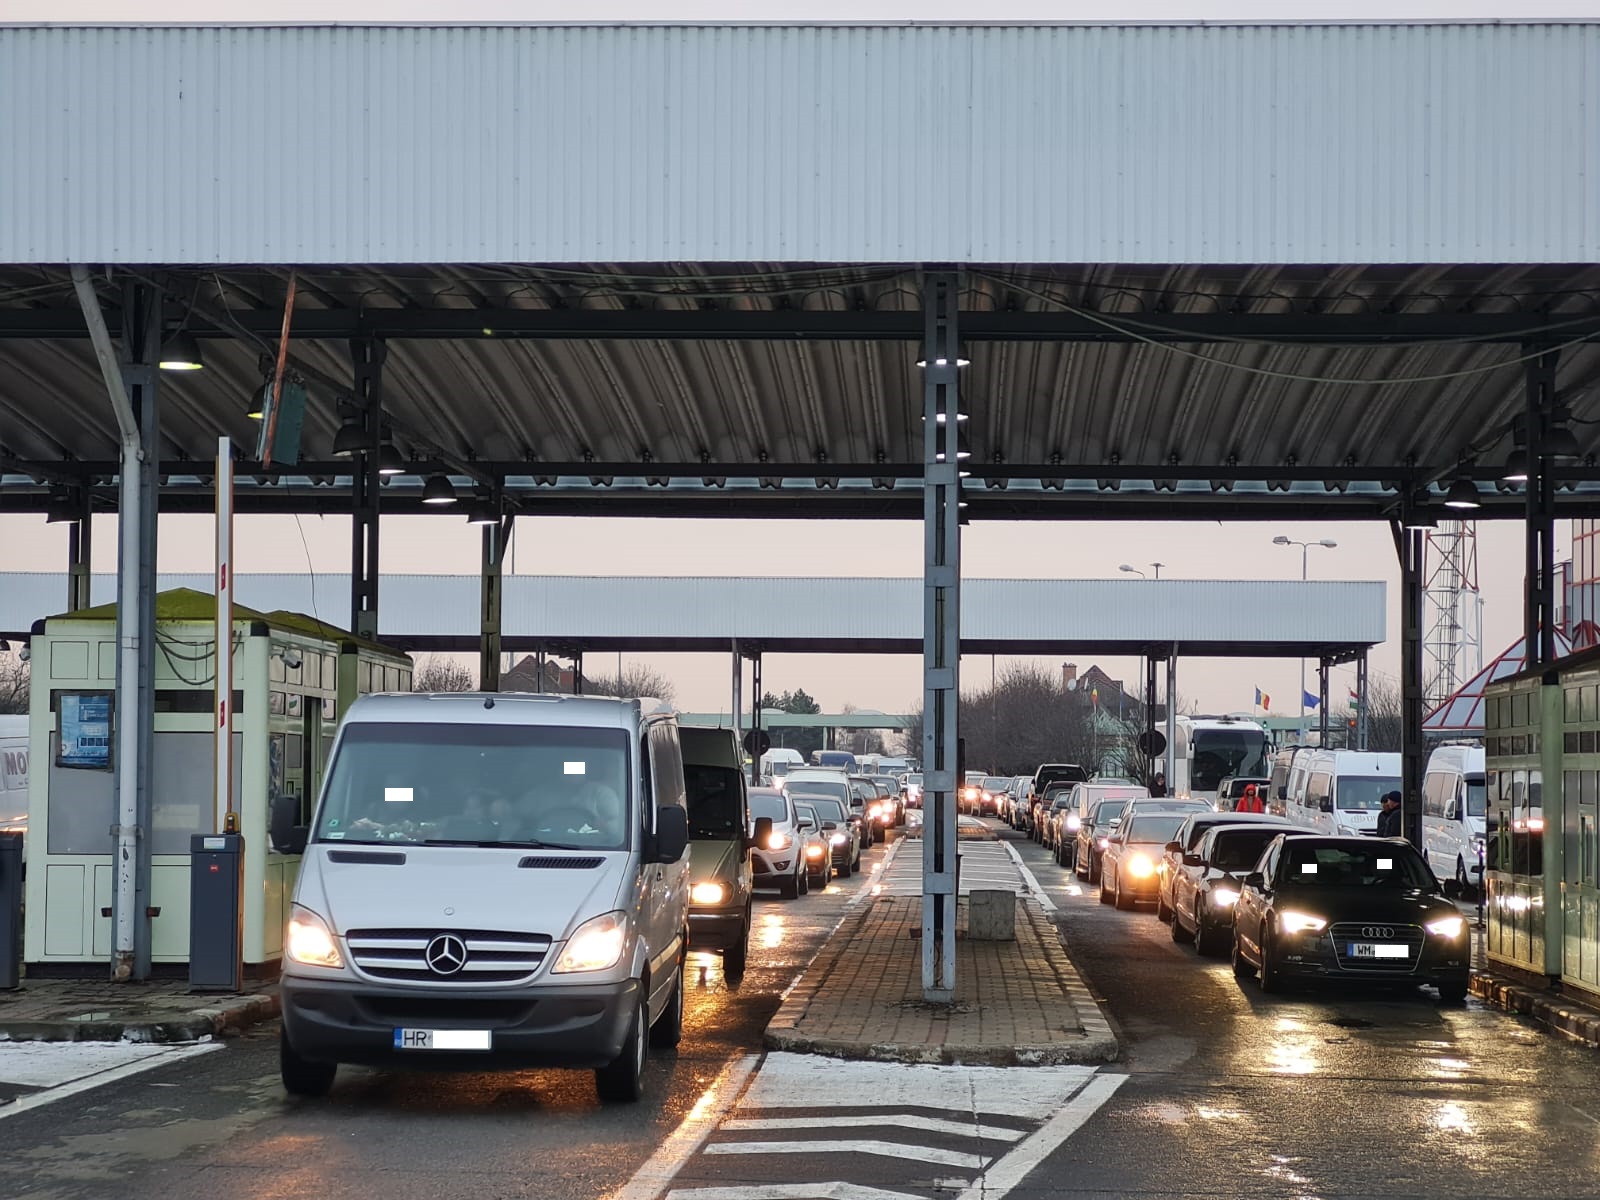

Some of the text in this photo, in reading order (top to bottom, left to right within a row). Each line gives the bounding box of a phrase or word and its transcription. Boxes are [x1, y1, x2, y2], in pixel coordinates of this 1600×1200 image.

[4, 751, 29, 775] MO
[1357, 944, 1371, 956] WM
[403, 1030, 427, 1047] HR
